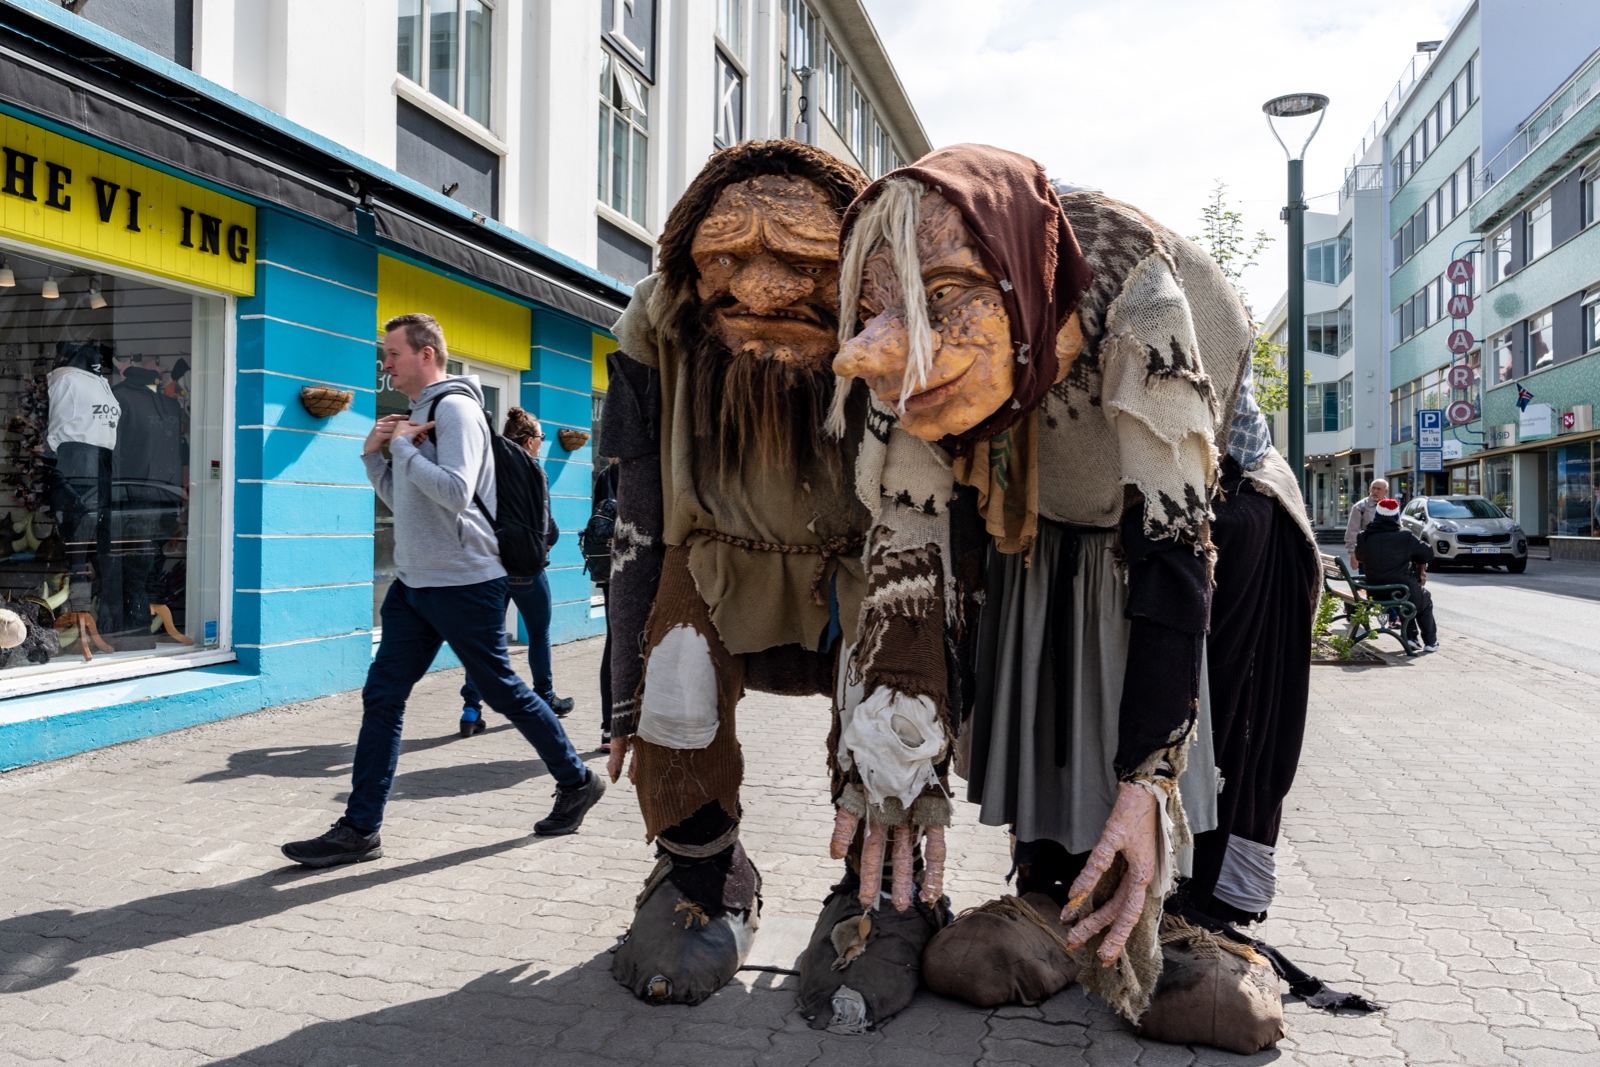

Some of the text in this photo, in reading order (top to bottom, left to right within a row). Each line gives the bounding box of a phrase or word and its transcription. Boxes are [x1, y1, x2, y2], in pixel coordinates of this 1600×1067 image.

[1451, 261, 1472, 423] AMARO
[1424, 413, 1437, 428] P
[1564, 415, 1574, 426] 24
